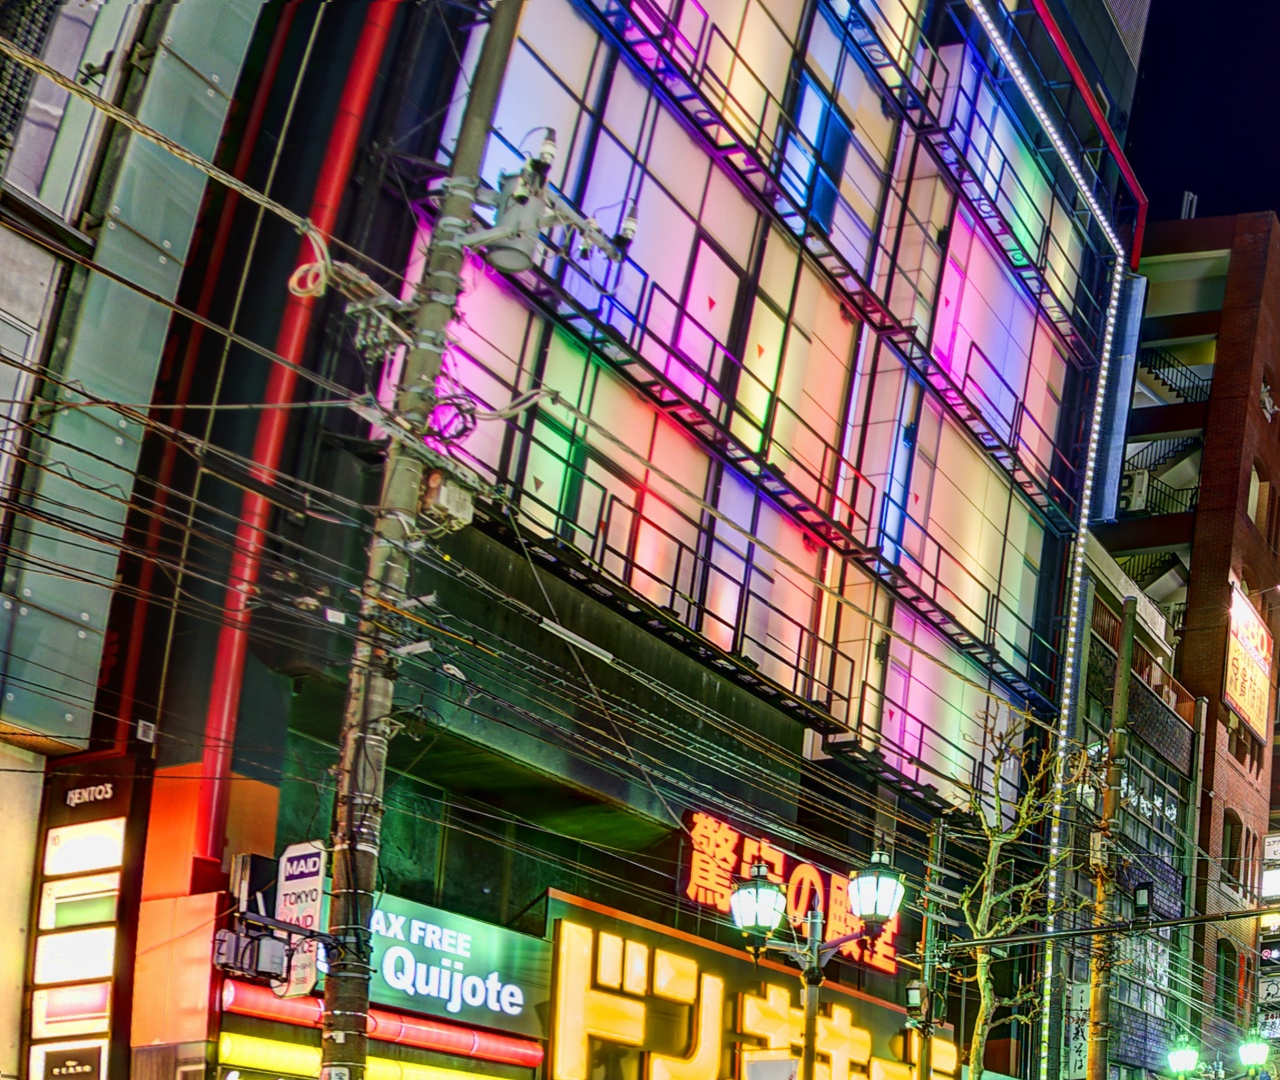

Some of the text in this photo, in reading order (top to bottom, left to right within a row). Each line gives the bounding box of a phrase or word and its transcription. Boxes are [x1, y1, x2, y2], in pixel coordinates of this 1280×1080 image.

[66, 783, 113, 806] KENTO'S
[285, 857, 320, 876] MAID
[282, 888, 318, 907] TOKYO
[371, 910, 472, 957] AX FREE
[382, 946, 525, 1015] Quijote
